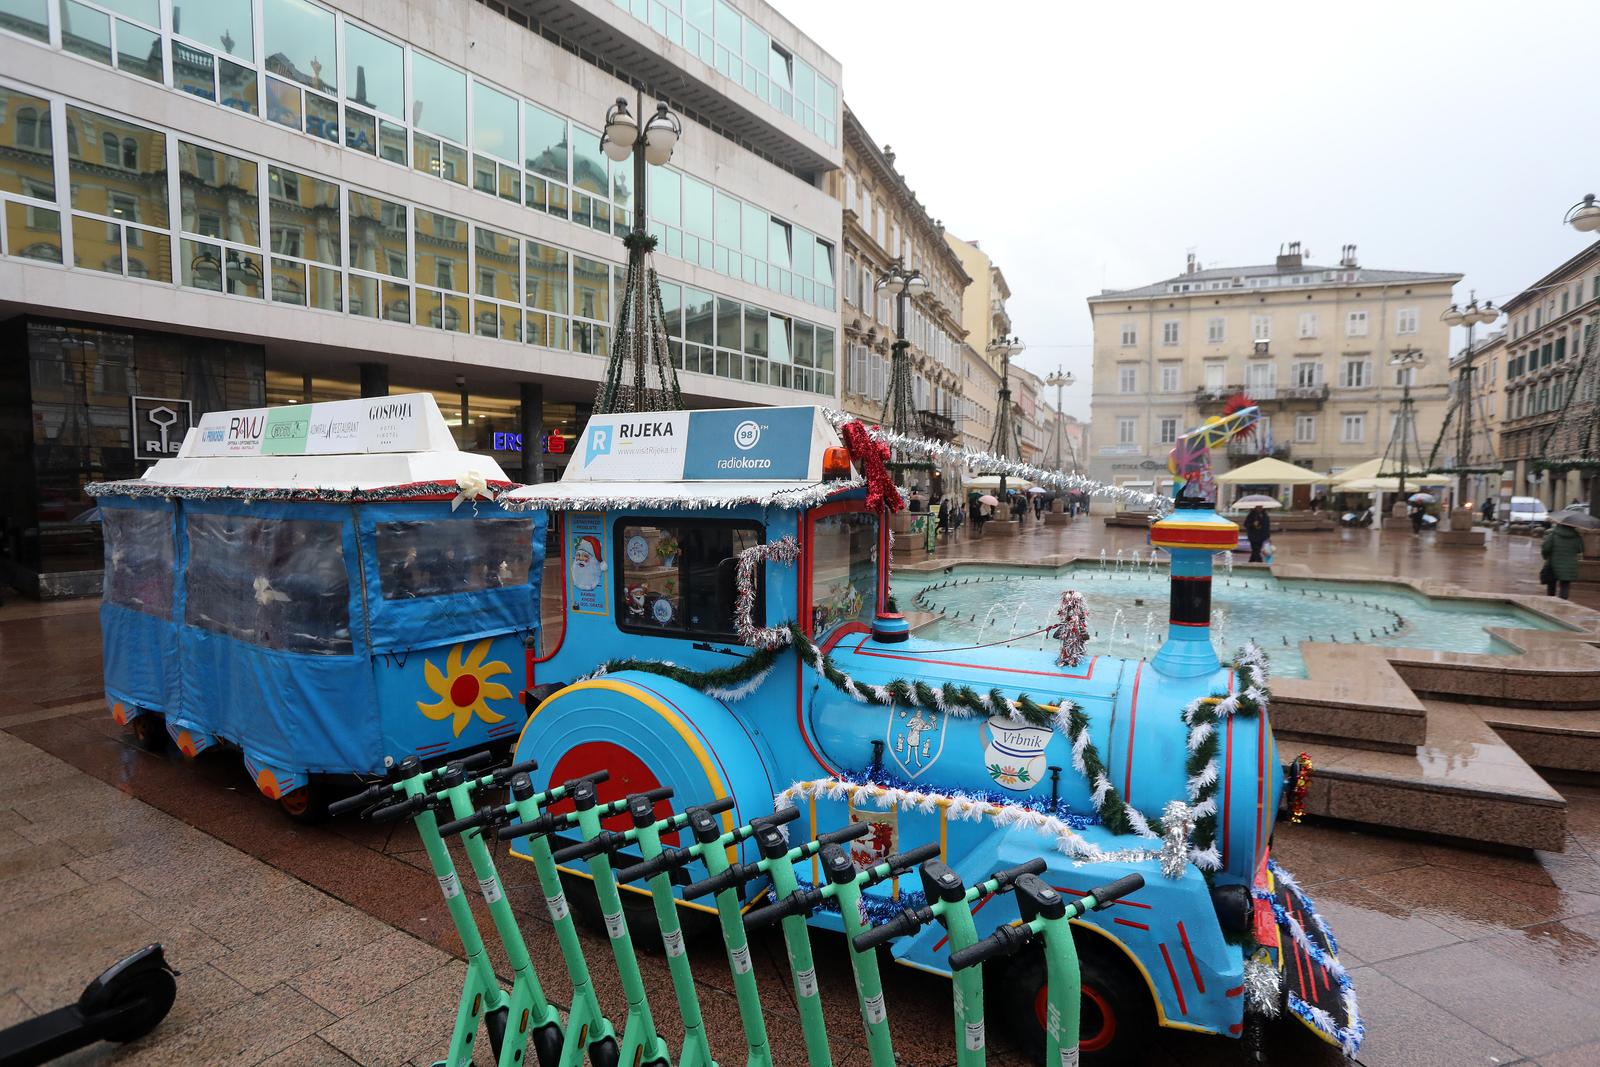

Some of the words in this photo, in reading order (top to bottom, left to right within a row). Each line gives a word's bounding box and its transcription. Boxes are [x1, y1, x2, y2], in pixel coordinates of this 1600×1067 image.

[619, 421, 674, 438] RIJEKA
[740, 431, 753, 439] 98
[717, 456, 771, 469] radiokorzo
[1003, 731, 1042, 748] Vrbnik
